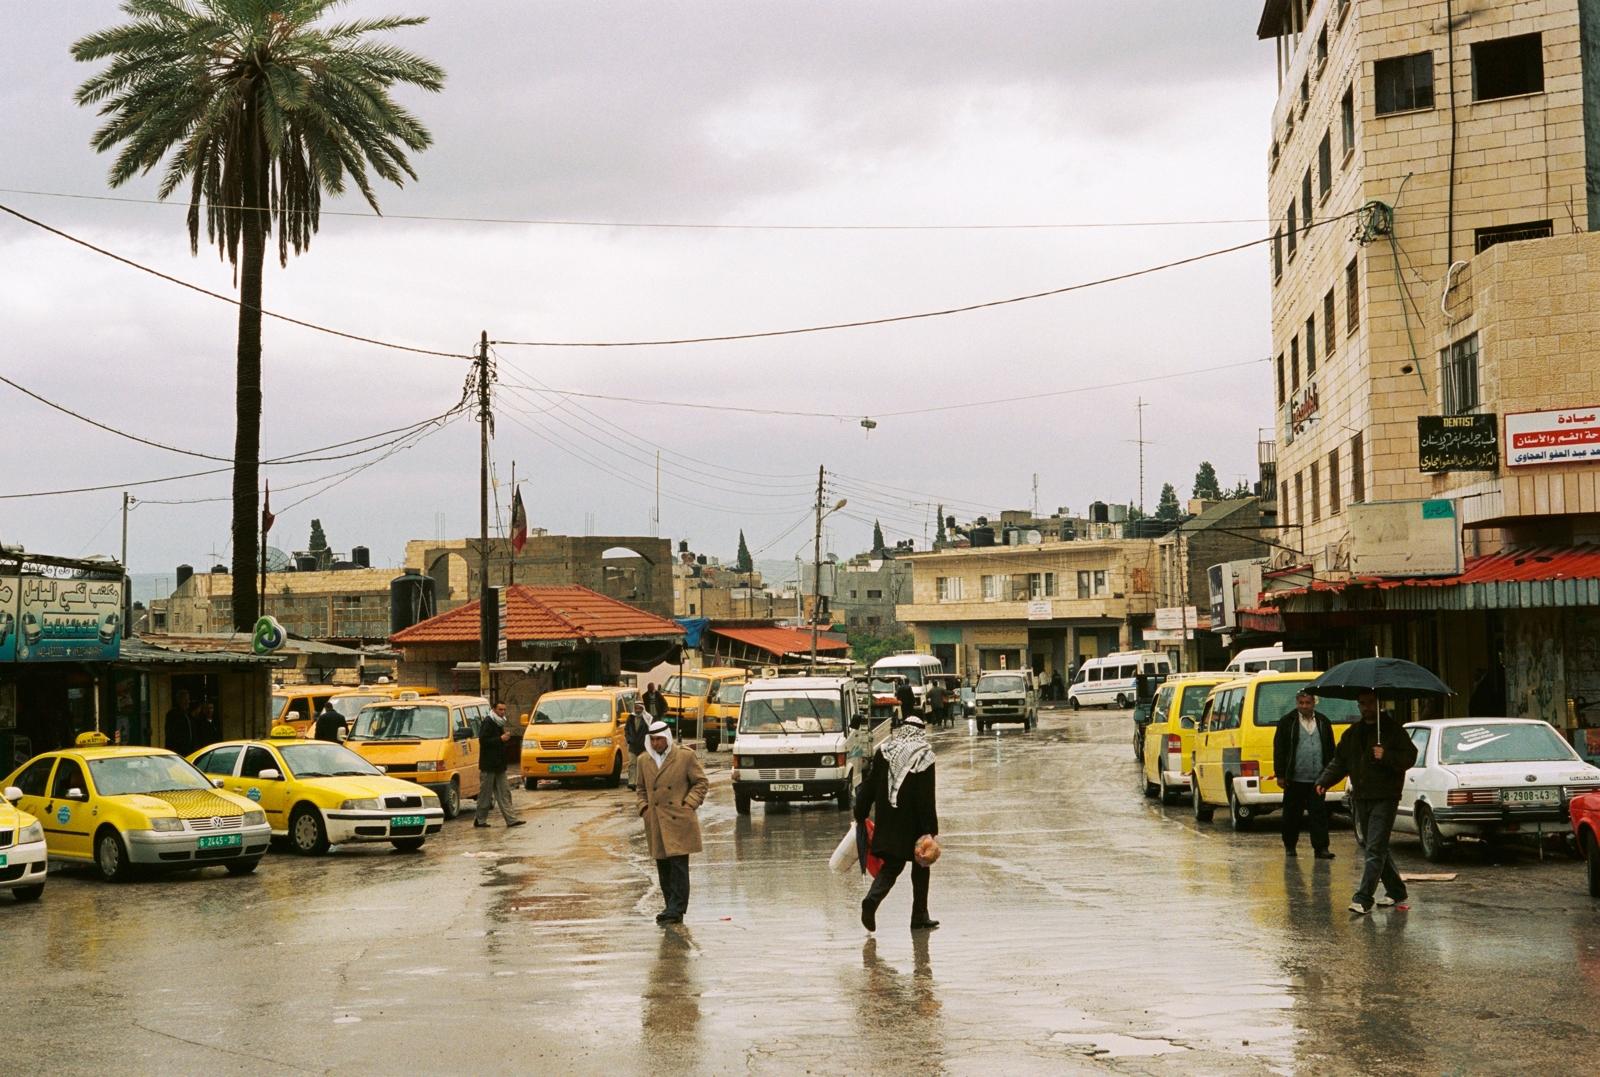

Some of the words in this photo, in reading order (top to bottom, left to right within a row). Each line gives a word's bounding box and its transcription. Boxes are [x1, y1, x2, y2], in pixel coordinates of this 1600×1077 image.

[1443, 417, 1474, 427] DENTIST
[1558, 413, 1596, 424] عيادة
[1558, 432, 1583, 443] الفم
